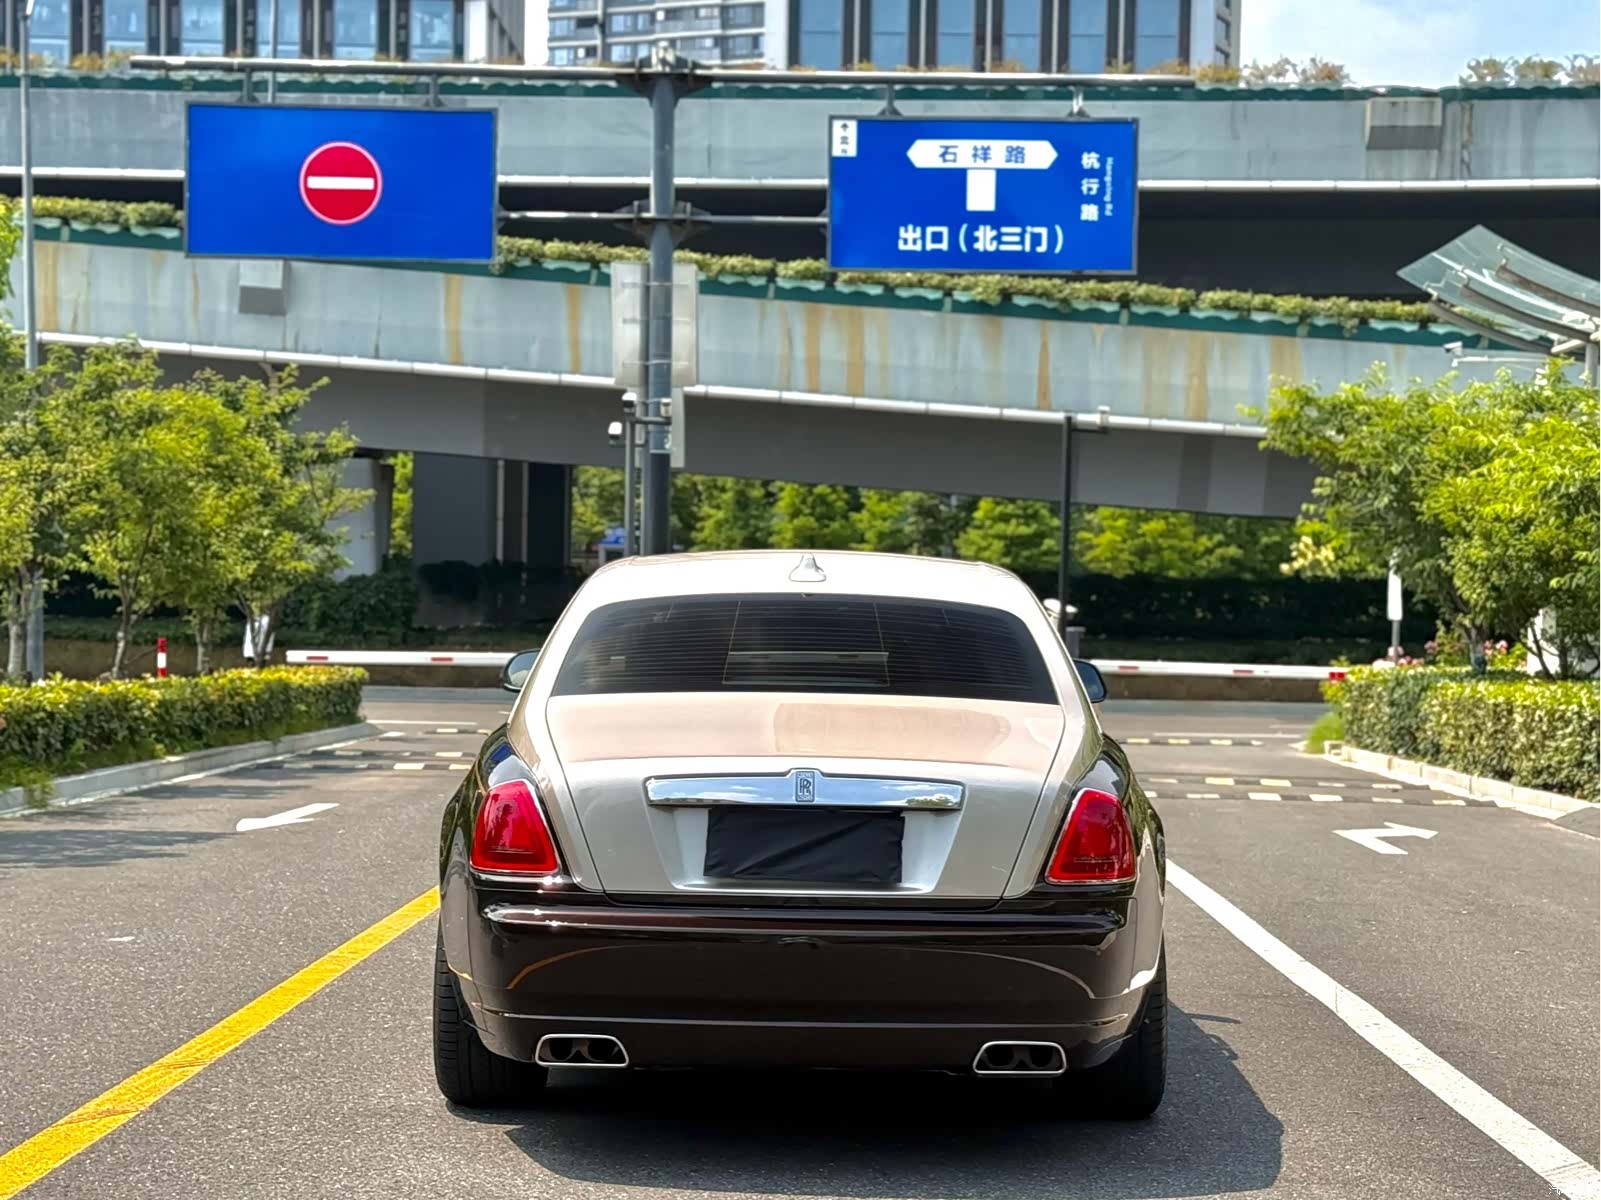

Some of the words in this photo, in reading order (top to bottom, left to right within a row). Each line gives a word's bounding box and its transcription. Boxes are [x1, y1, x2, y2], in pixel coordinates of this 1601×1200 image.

[938, 144, 1026, 164] 石祥路
[1080, 151, 1100, 222] 杭行路
[898, 223, 1064, 254] 出口（北三门）
